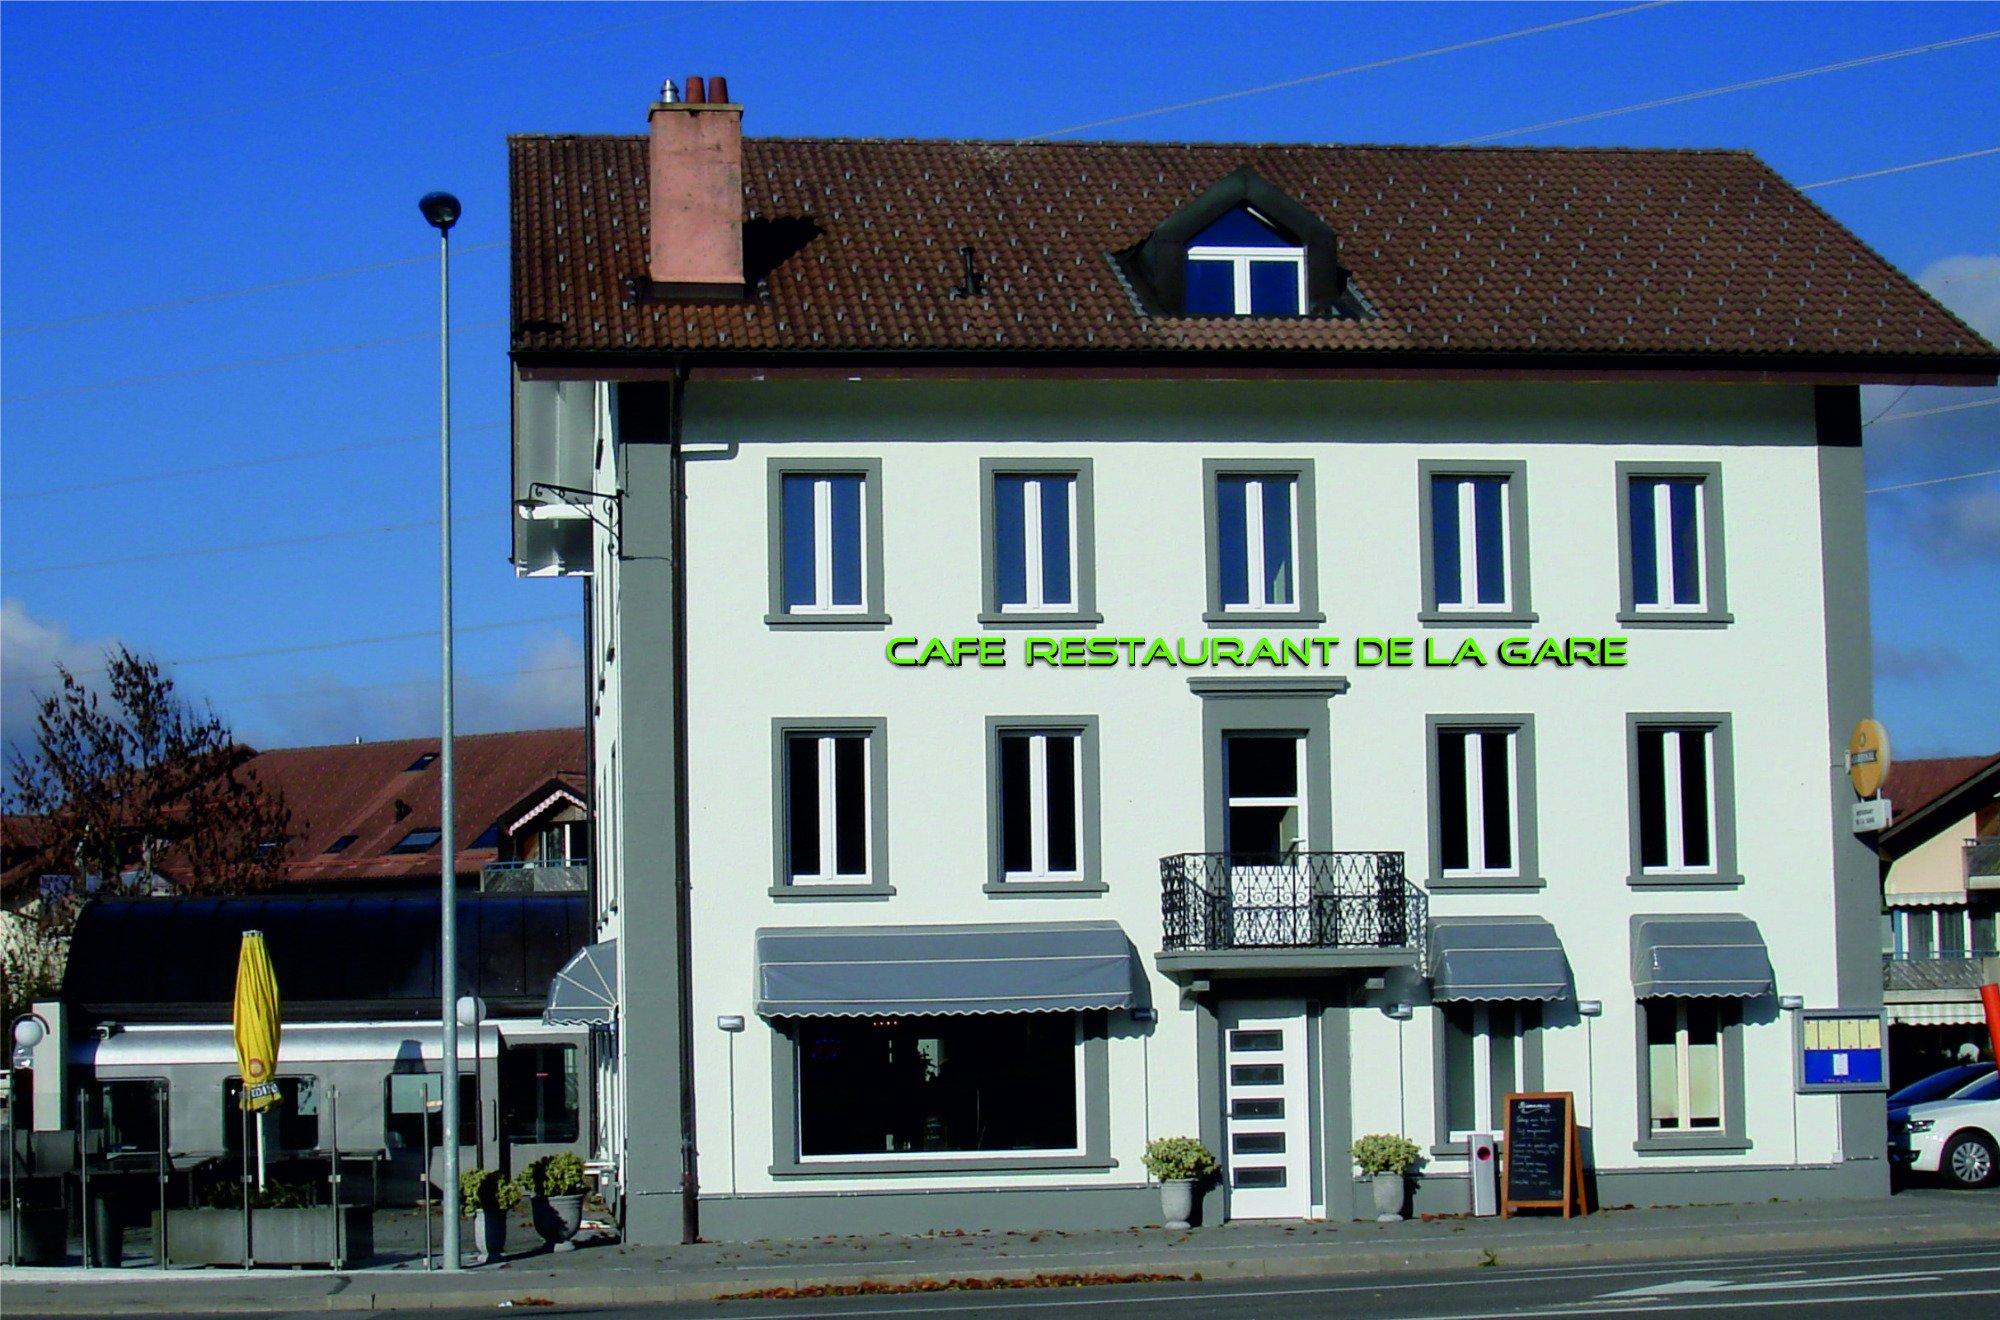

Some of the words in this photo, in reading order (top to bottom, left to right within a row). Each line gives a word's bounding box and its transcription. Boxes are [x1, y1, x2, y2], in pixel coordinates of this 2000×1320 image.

[886, 637, 1005, 666] CAFE
[1025, 637, 1339, 666] RESTAURANT
[1357, 637, 1414, 666] DE
[1426, 637, 1488, 666] LA
[1499, 637, 1628, 666] GARE
